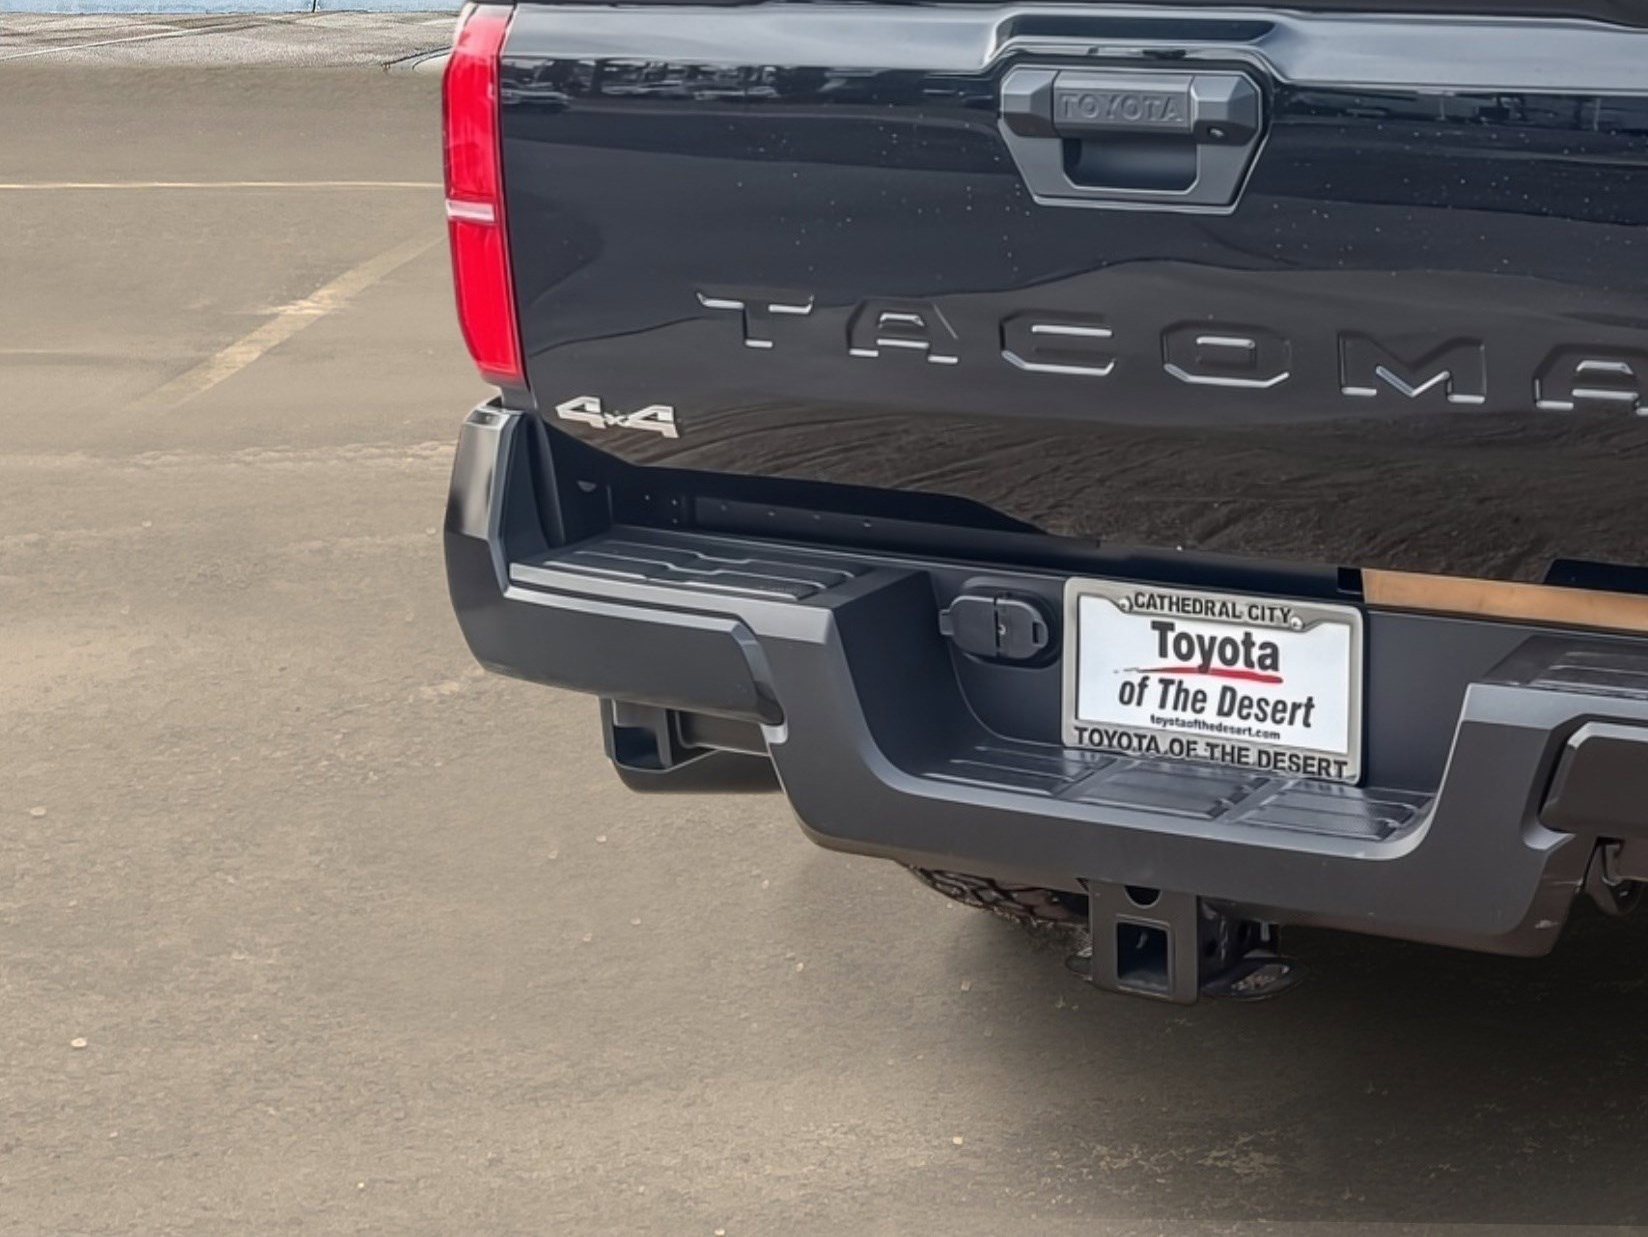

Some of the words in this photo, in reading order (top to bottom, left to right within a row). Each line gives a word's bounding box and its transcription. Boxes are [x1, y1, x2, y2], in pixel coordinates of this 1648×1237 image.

[1060, 93, 1184, 123] TOYOTA
[1134, 592, 1242, 620] CATHEDRAL
[1248, 604, 1292, 624] CITY
[1151, 620, 1280, 673] Toyota
[1118, 676, 1150, 707] of
[1158, 677, 1207, 714] The
[1217, 685, 1315, 729] Desert
[1150, 714, 1281, 741] toyotaofthedesert.com
[1074, 726, 1160, 755] TOYOTA
[1169, 737, 1199, 758] OF
[1206, 742, 1251, 766] THE
[1257, 749, 1348, 779] DESERT
